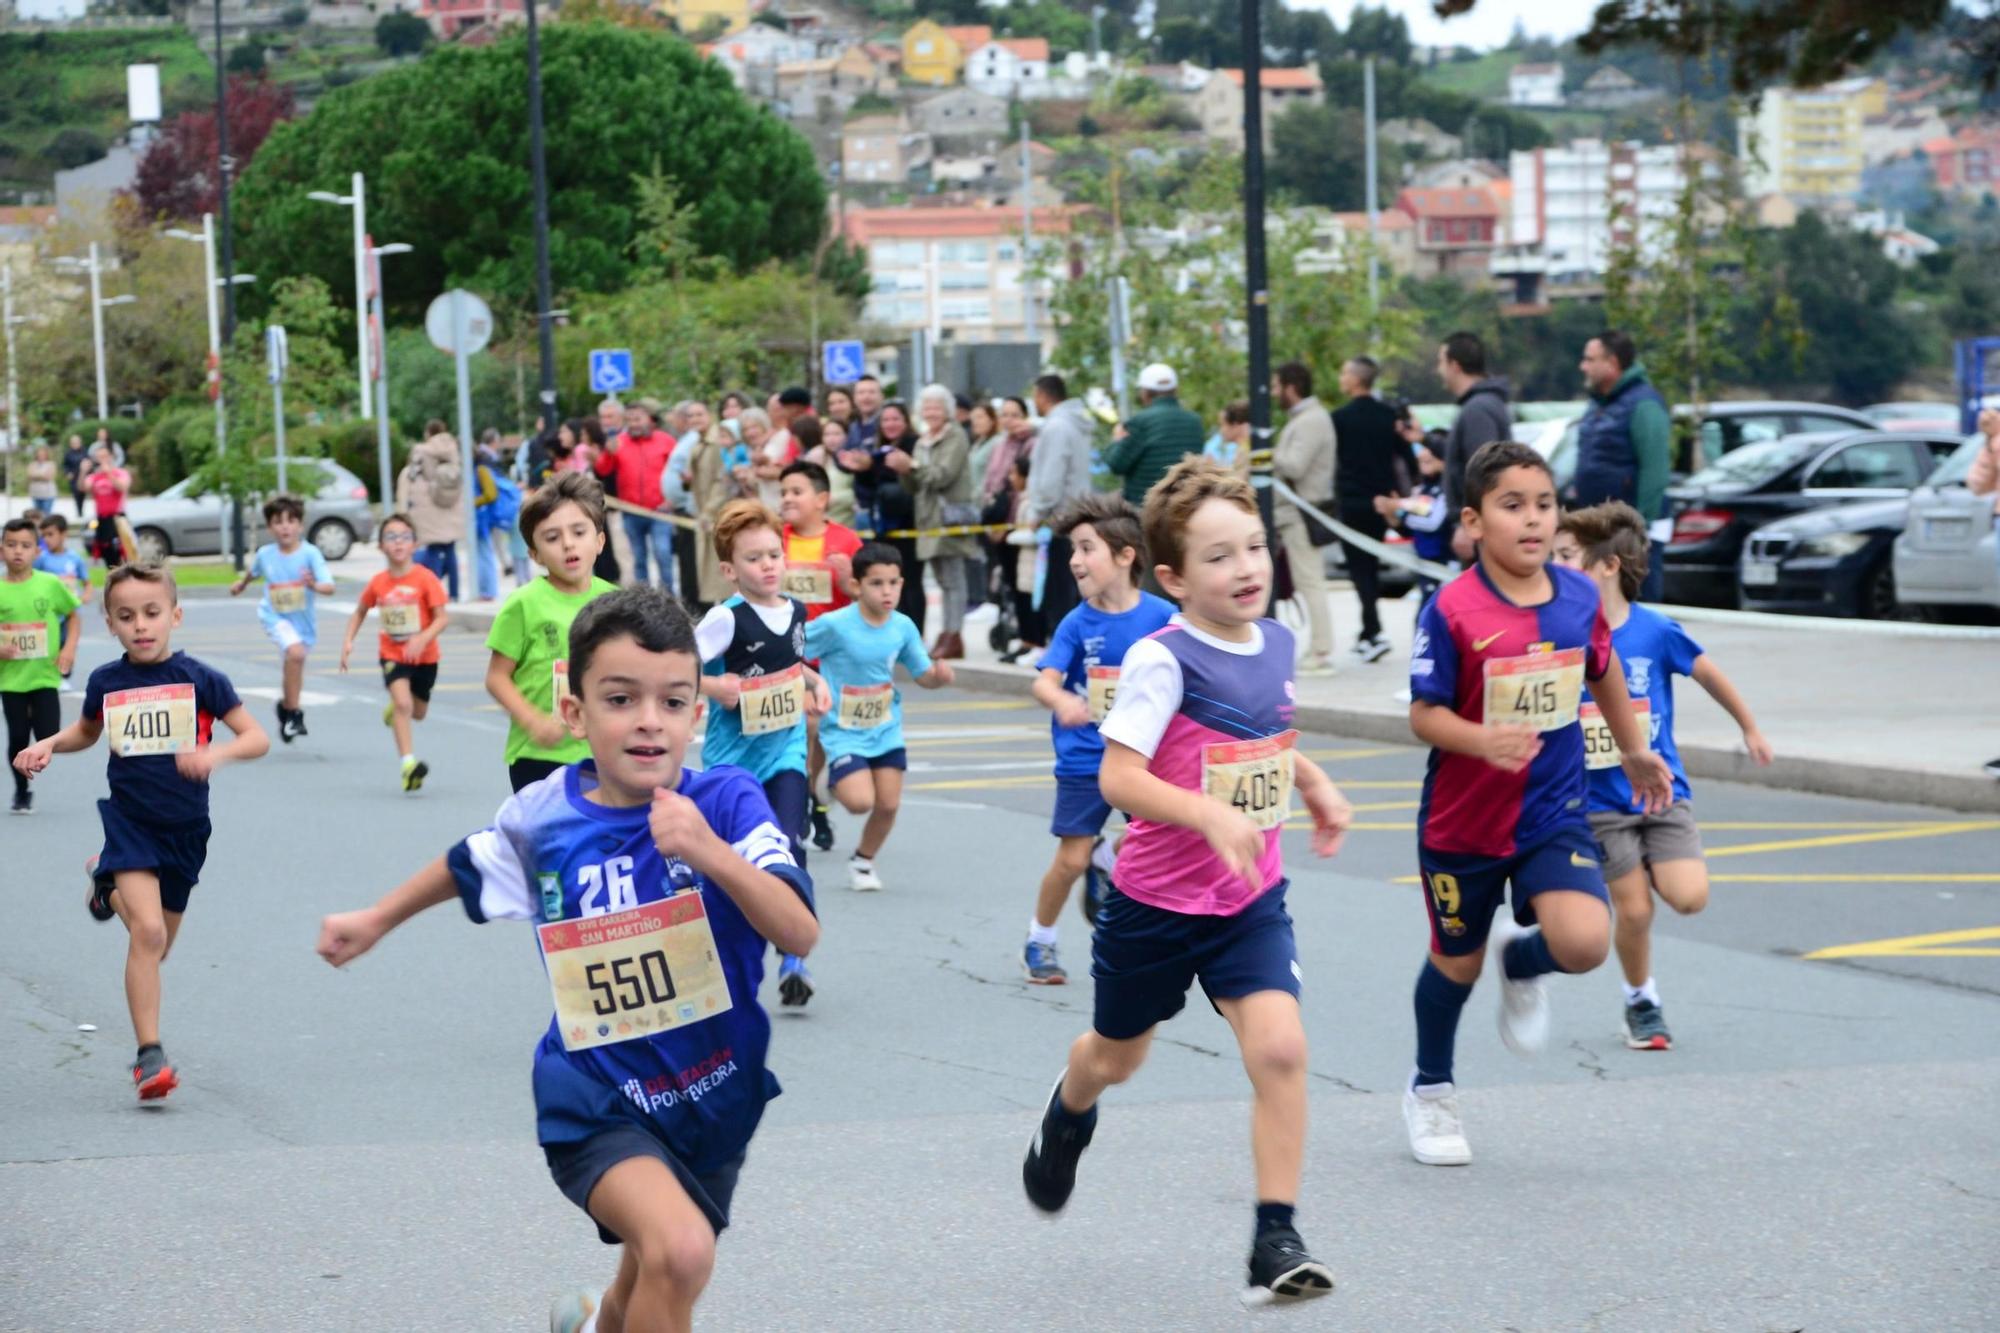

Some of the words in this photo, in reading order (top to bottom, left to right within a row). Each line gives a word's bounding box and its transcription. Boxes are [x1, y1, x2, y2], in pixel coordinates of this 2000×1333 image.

[760, 690, 795, 718] 405
[853, 700, 882, 719] 428
[1514, 681, 1557, 716] 415
[123, 711, 170, 739] 400
[1585, 726, 1618, 754] 55
[1232, 769, 1278, 812] 406
[577, 855, 639, 917] 26
[580, 929, 604, 945] SAN
[606, 917, 662, 940] MARTIÑO
[585, 950, 677, 1016] 550
[650, 1060, 738, 1112] PONTEVEDRA
